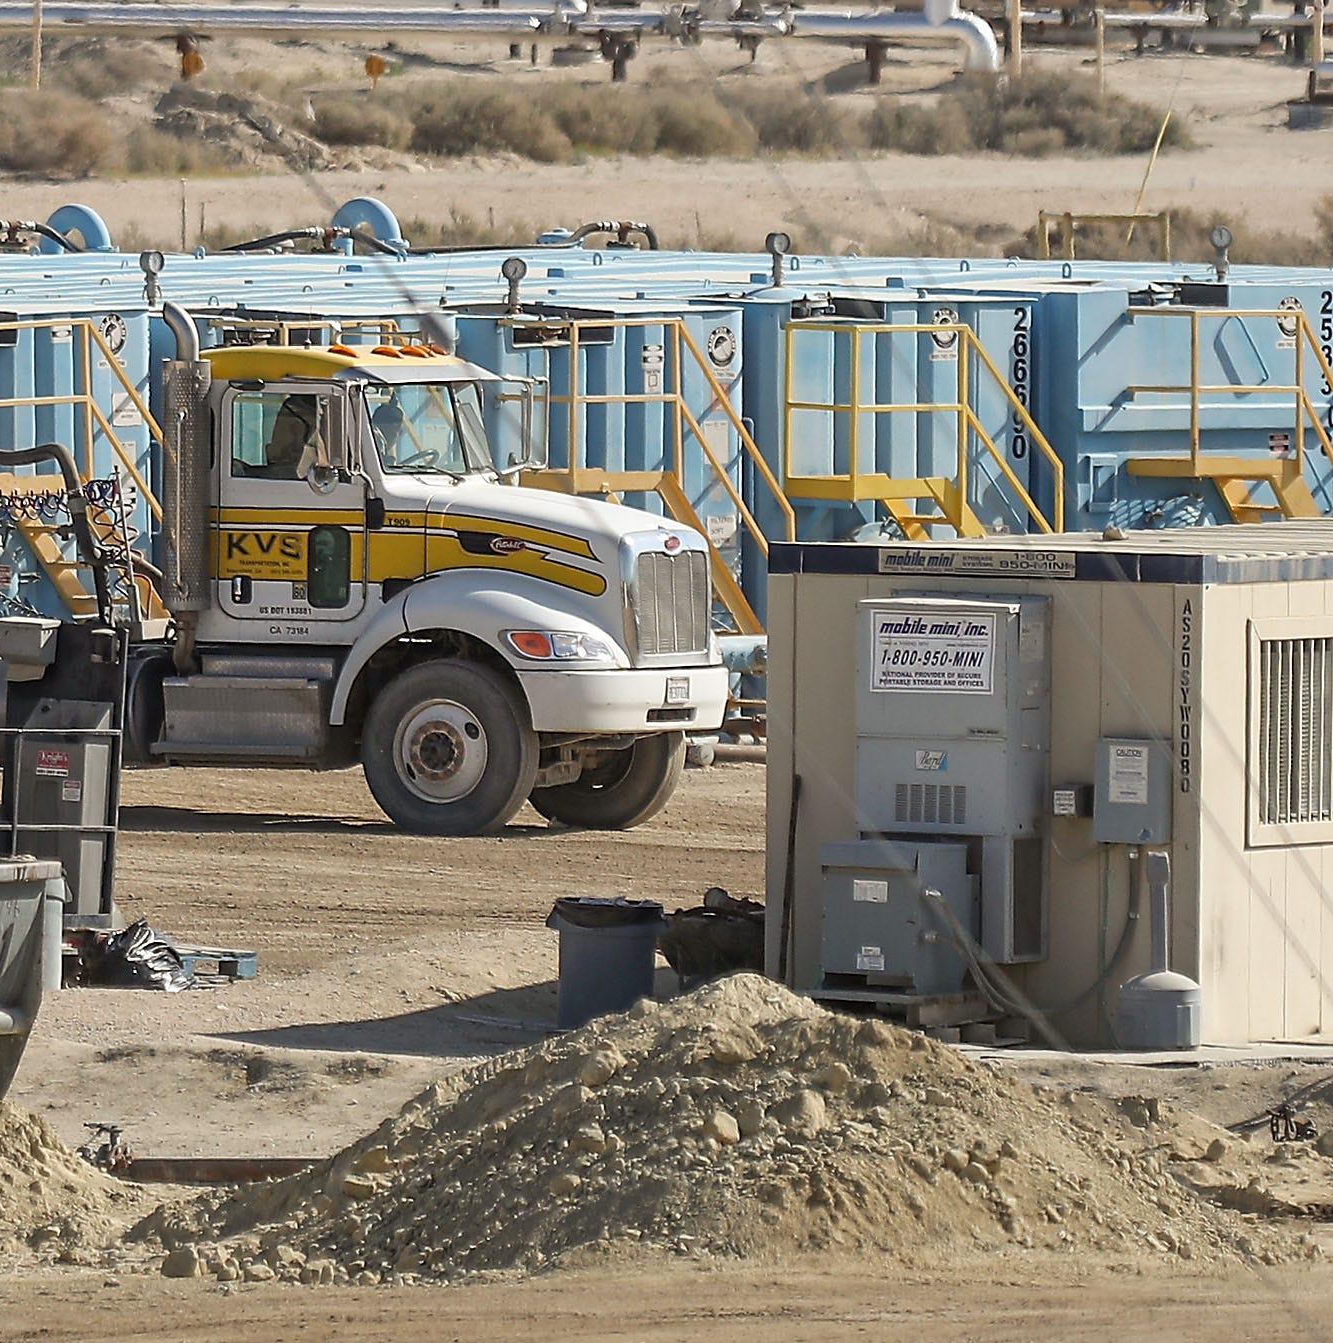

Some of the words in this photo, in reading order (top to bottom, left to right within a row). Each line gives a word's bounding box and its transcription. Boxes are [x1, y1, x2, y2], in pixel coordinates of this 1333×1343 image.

[227, 533, 302, 559] KVS
[885, 550, 926, 567] mobile
[926, 554, 956, 568] mini
[1014, 553, 1056, 561] 1-800
[259, 606, 269, 614] US
[270, 606, 284, 614] DOT
[269, 626, 282, 635] CA
[879, 617, 928, 635] mobile
[964, 621, 989, 636] inc.
[881, 649, 984, 668] 1-800-950-MINI
[879, 678, 911, 686] PORTABLE
